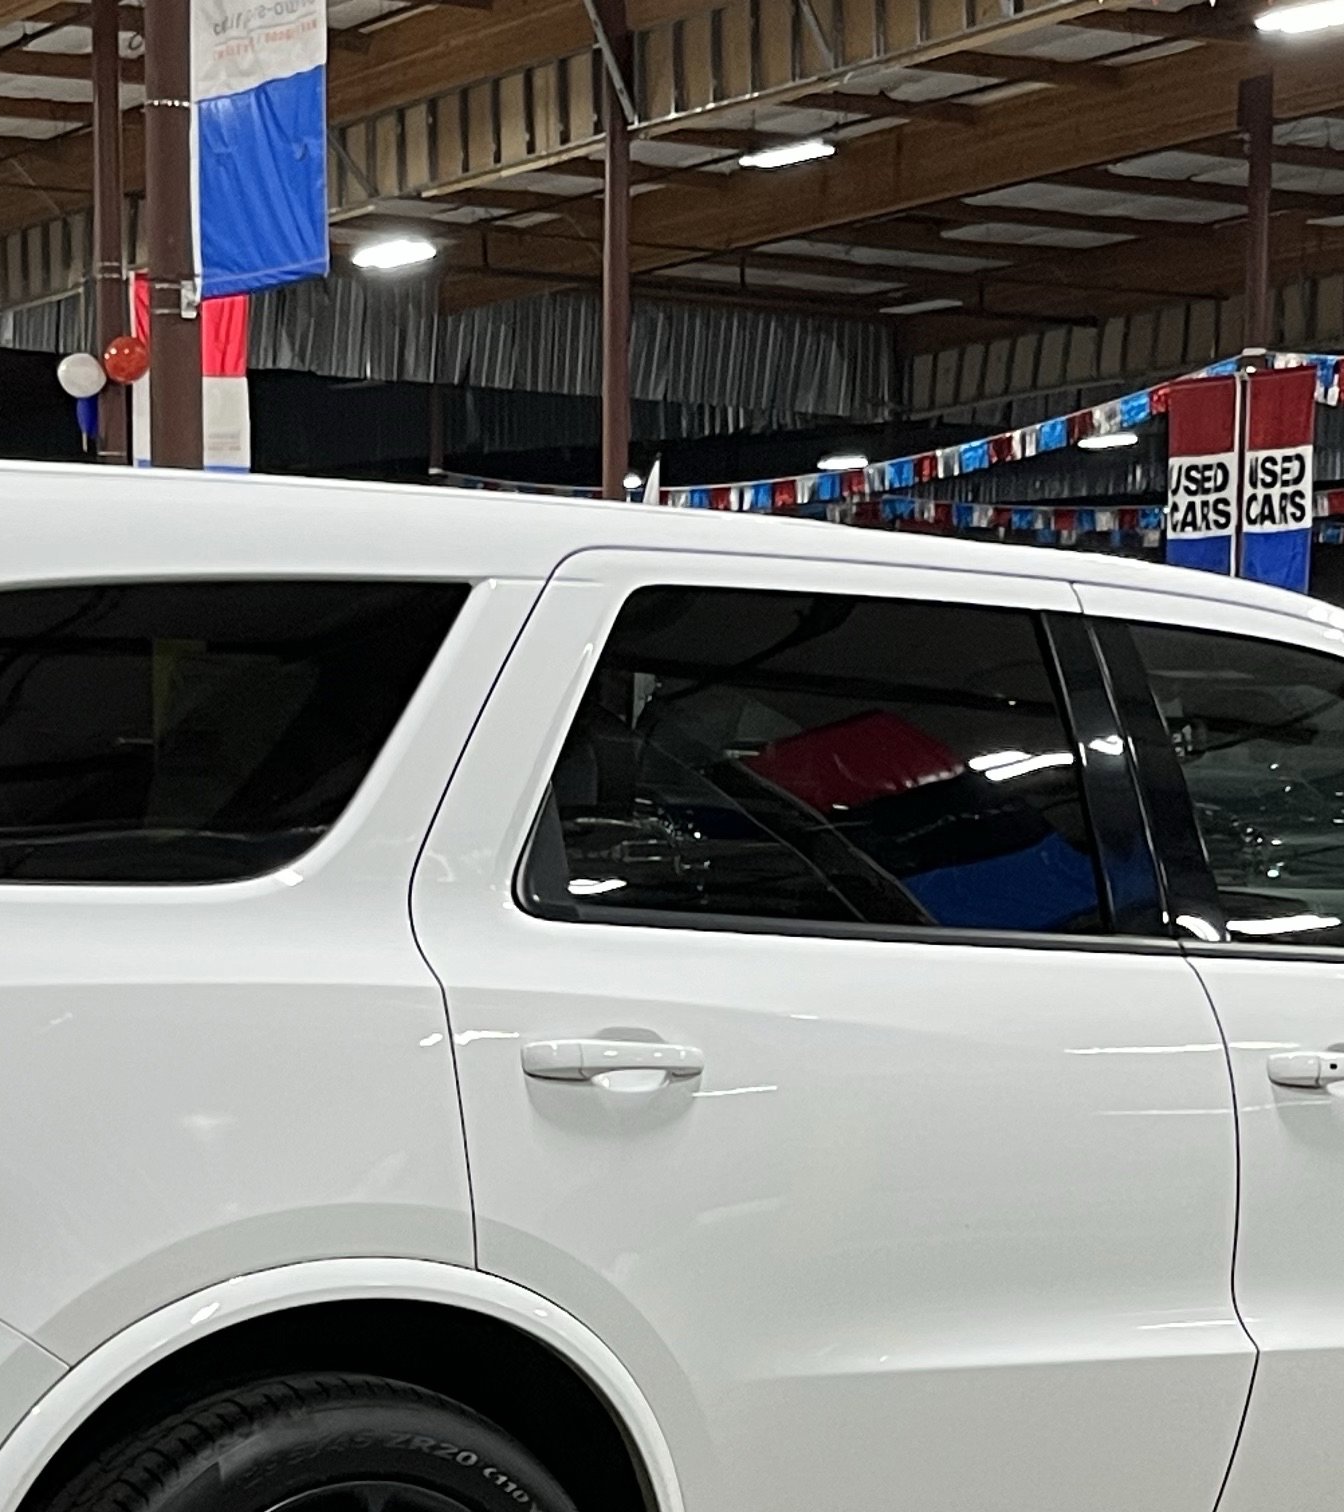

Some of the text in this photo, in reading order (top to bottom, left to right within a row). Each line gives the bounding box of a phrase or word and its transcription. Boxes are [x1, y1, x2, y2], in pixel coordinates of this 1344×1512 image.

[1170, 462, 1229, 496] USED
[1249, 453, 1306, 489] USED
[1169, 497, 1231, 533] CARS
[1246, 489, 1306, 526] CARS
[383, 1433, 478, 1466] ZR20
